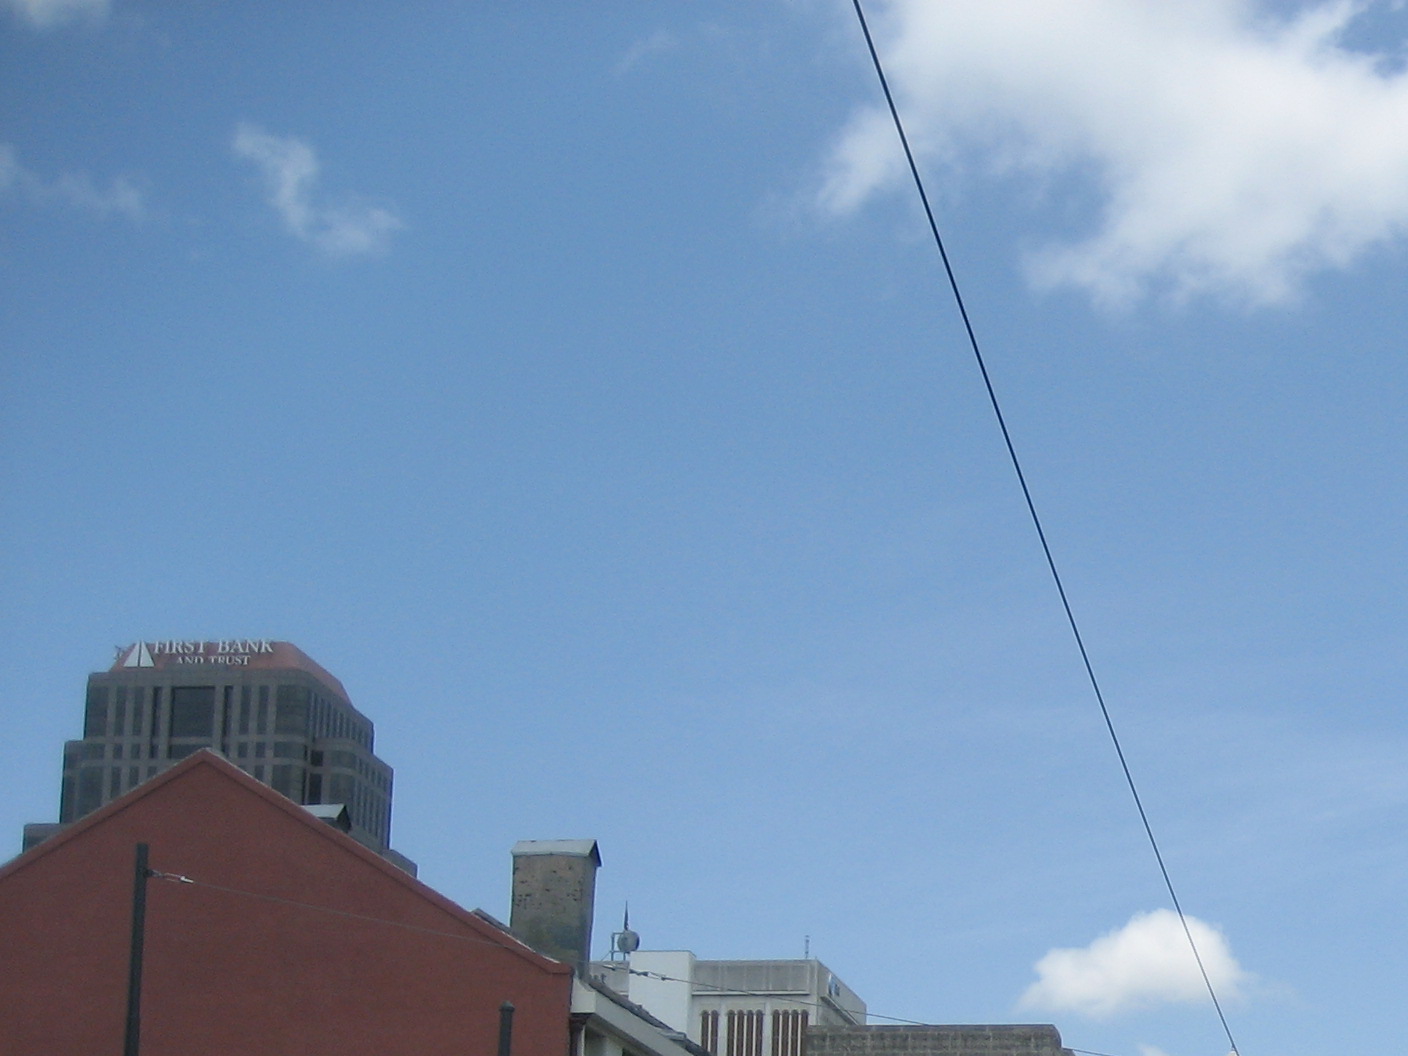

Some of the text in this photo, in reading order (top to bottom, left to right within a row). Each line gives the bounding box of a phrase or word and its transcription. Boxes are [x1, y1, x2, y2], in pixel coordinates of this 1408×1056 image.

[154, 639, 274, 654] FIRST BANK
[176, 655, 251, 666] AND TRUST
